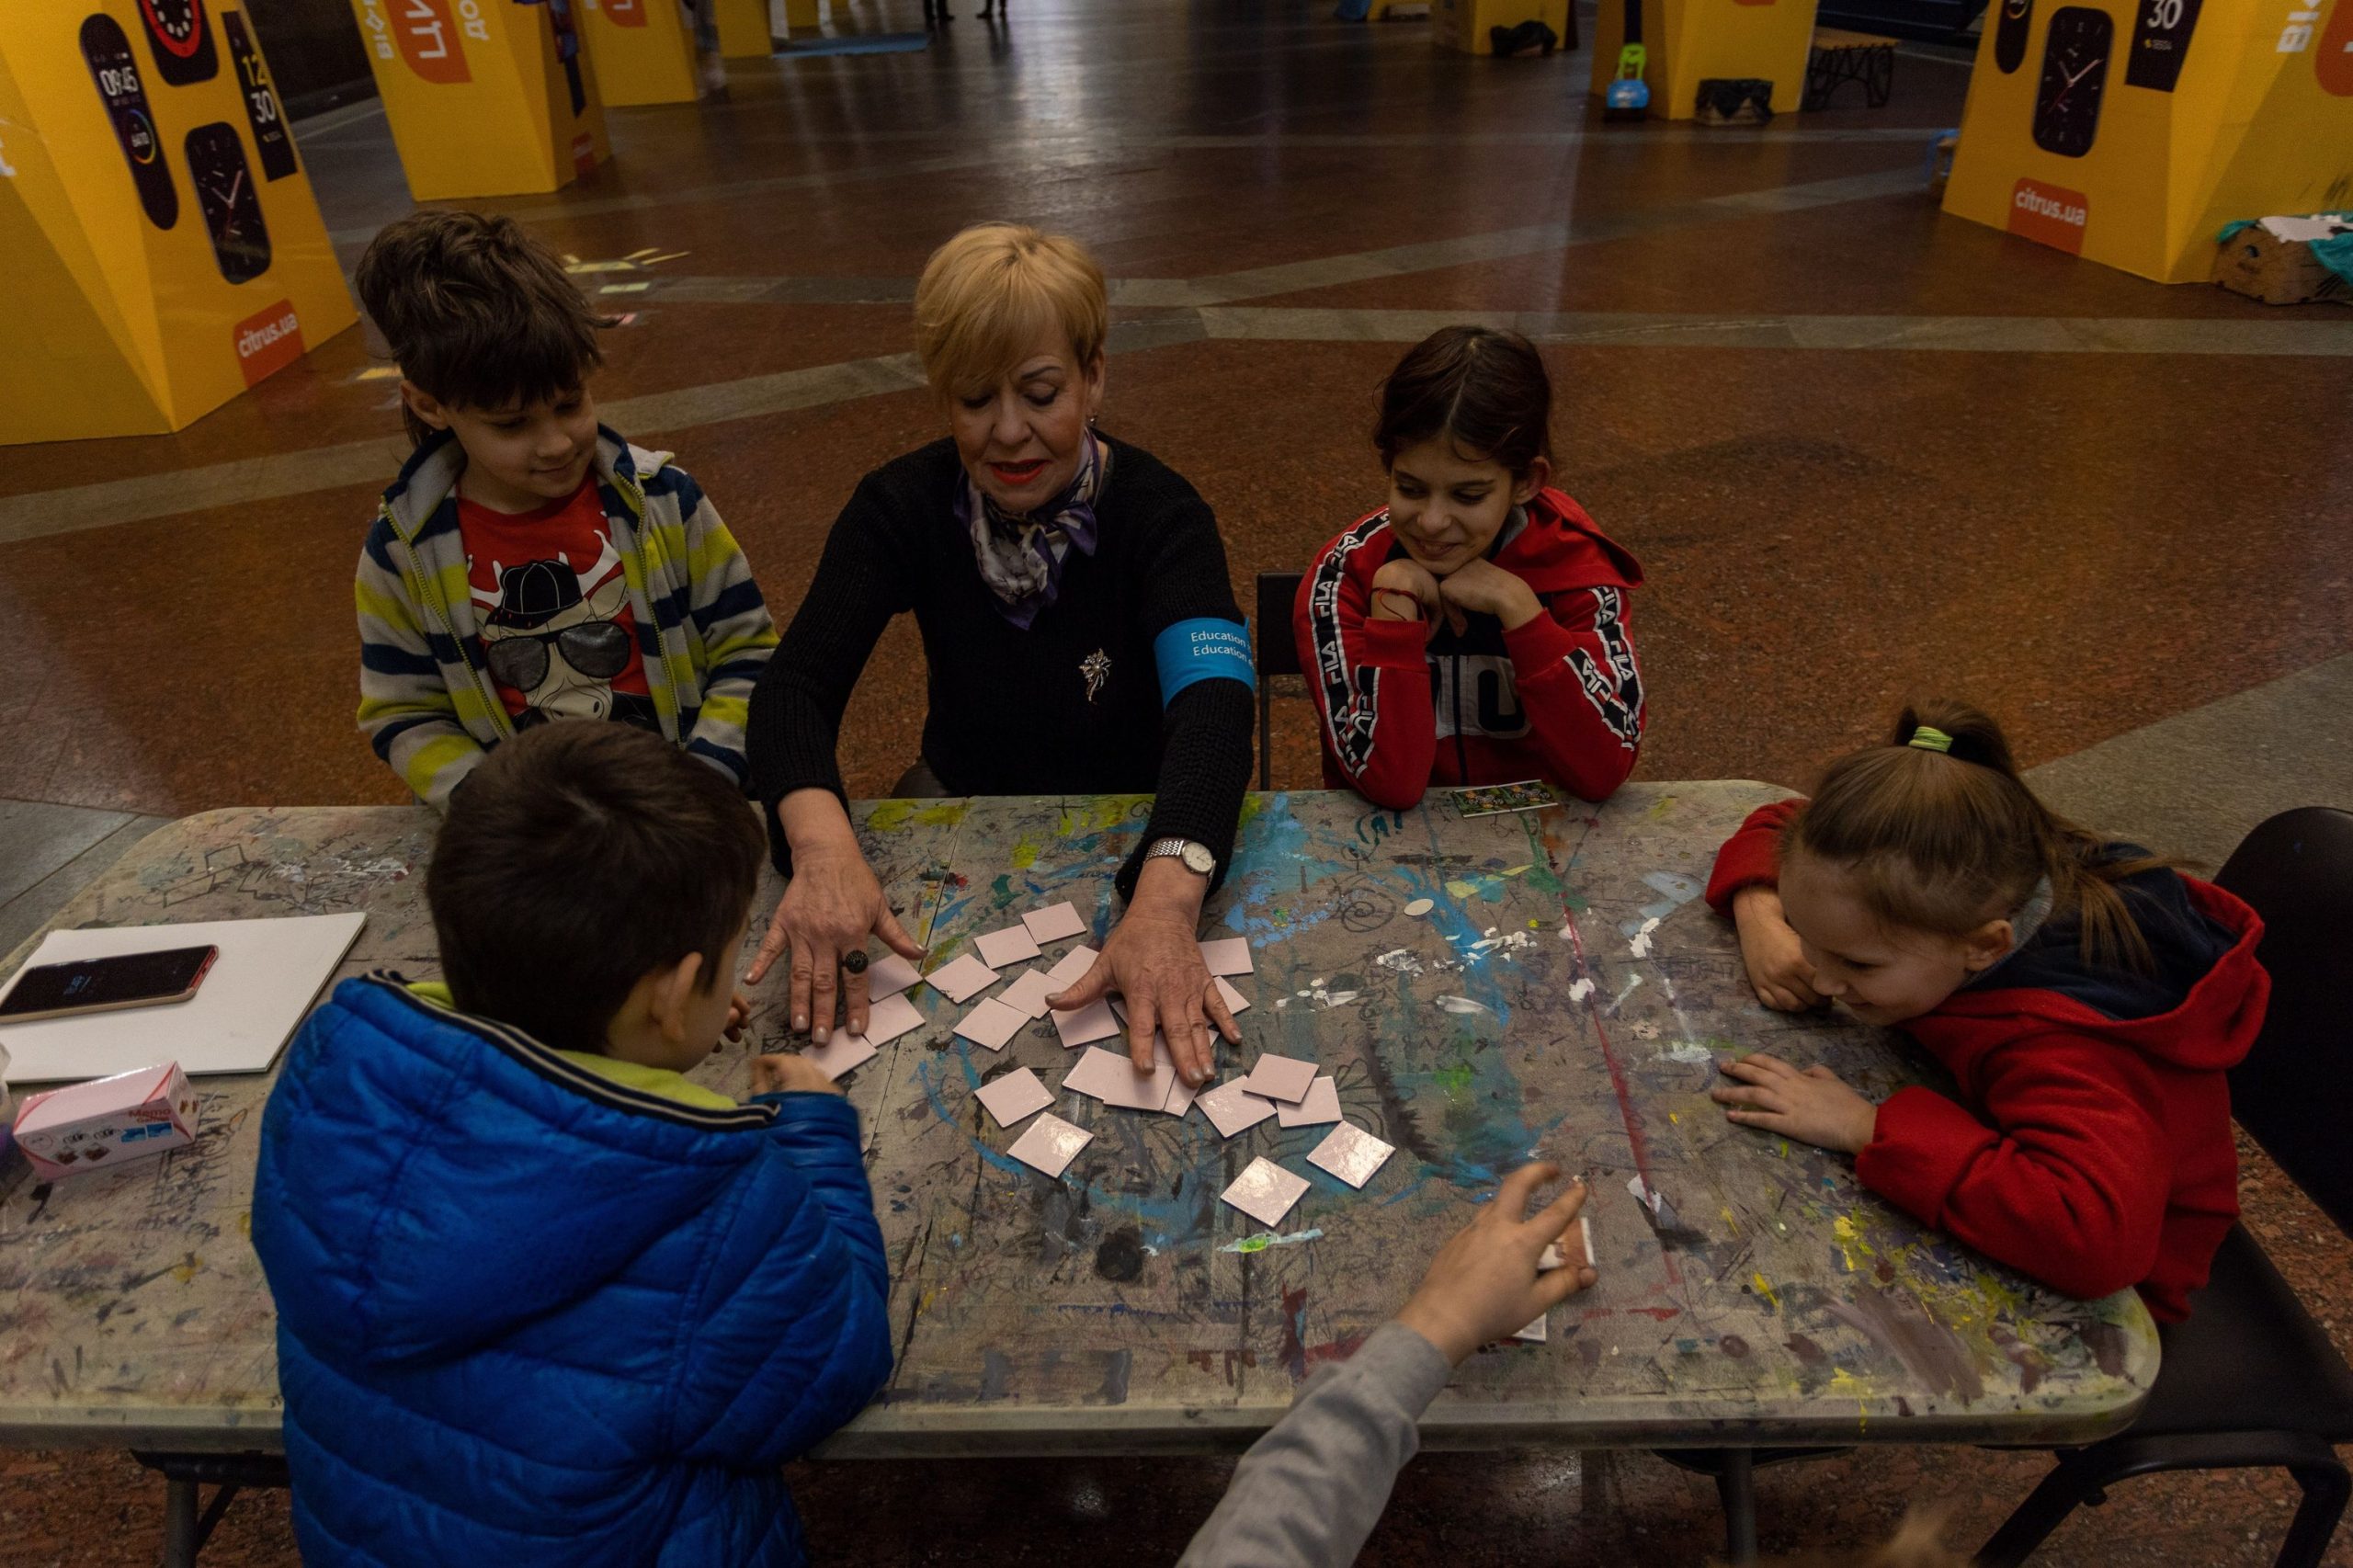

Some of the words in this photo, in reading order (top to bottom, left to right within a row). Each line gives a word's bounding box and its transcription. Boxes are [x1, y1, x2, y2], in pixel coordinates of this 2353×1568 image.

[2015, 187, 2086, 227] citrus.ua
[238, 312, 299, 358] citrus.ua
[1314, 580, 1335, 618] FILA
[1190, 630, 1246, 647] Education
[1192, 644, 1247, 662] Education
[1321, 641, 1342, 686] FILA
[1610, 640, 1634, 681] FILA
[1583, 657, 1611, 705] FILA
[129, 1108, 172, 1119] Memo
